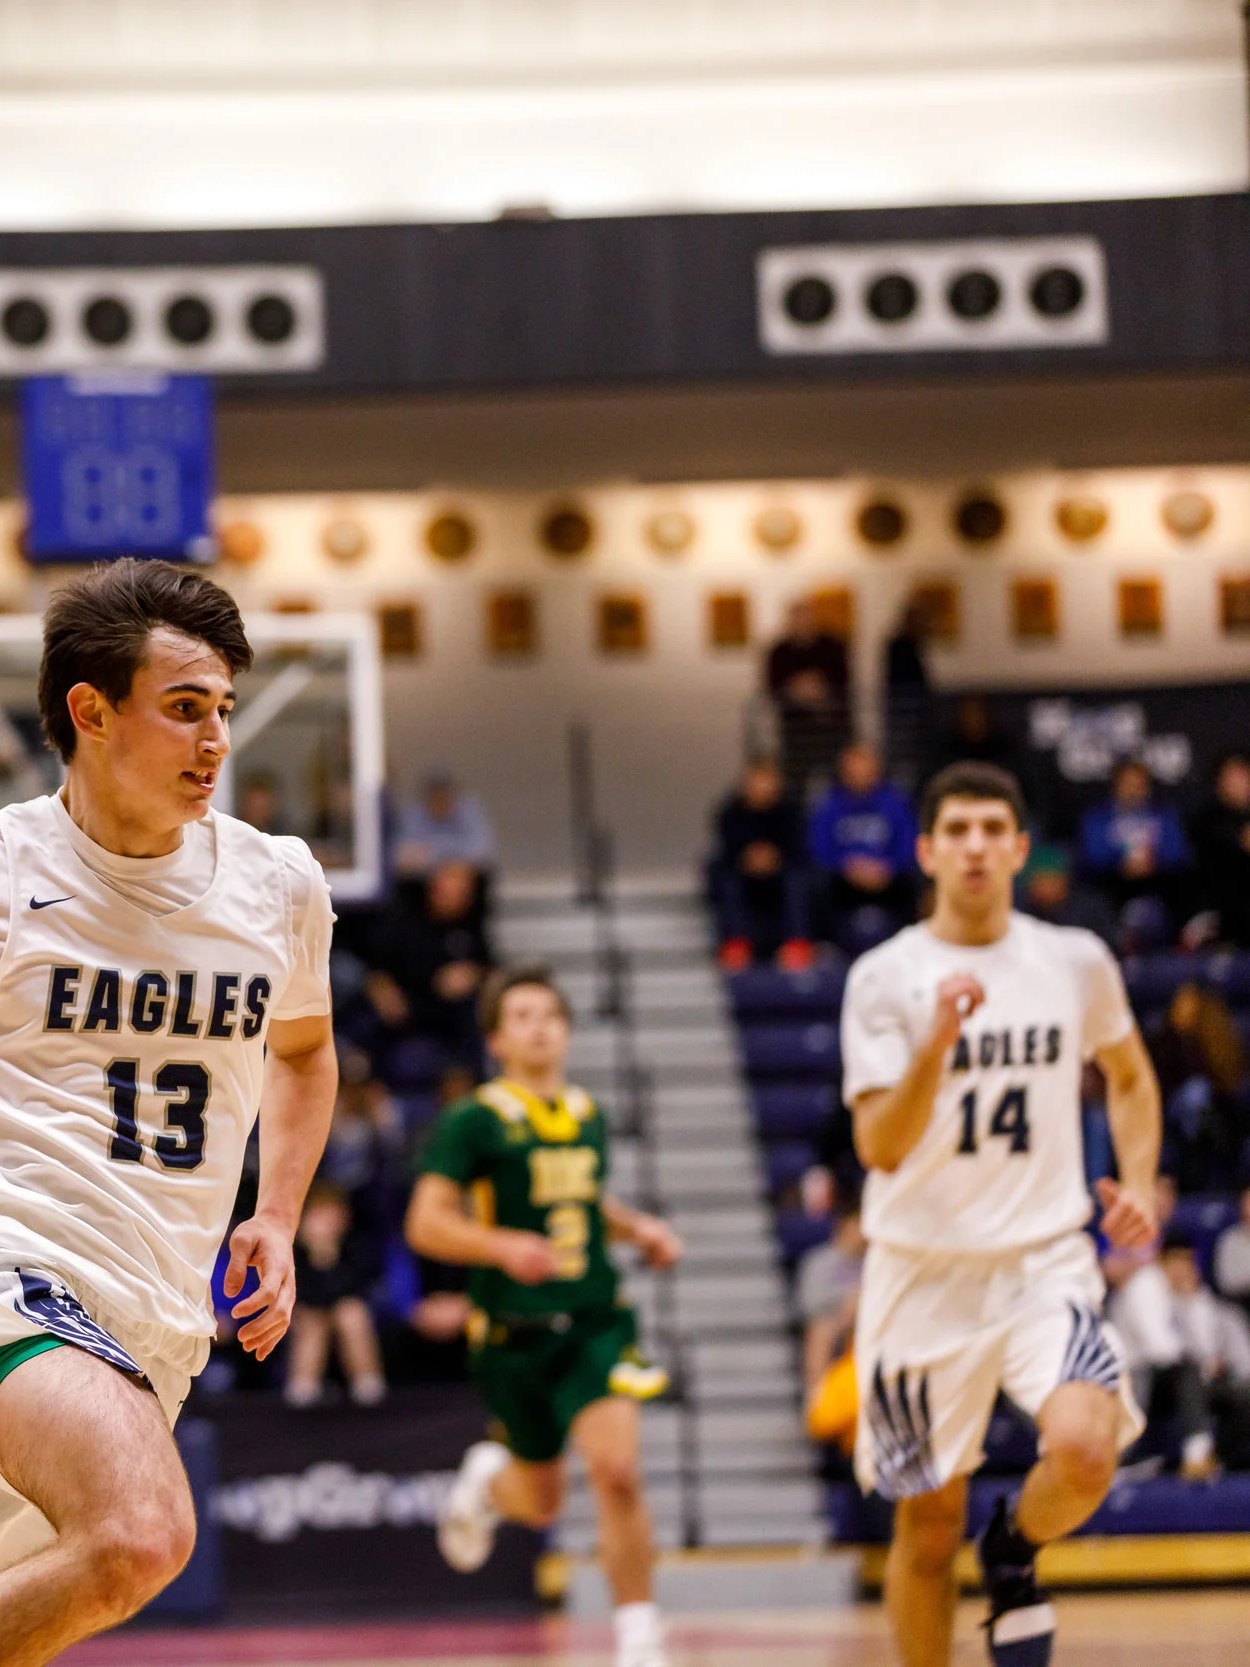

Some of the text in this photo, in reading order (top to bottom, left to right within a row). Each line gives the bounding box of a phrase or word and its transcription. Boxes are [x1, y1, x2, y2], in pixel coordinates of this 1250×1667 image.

[42, 963, 272, 1042] EAGLES
[950, 1022, 1062, 1073] AGLES
[103, 1056, 213, 1173] 13
[955, 1083, 1031, 1155] 14
